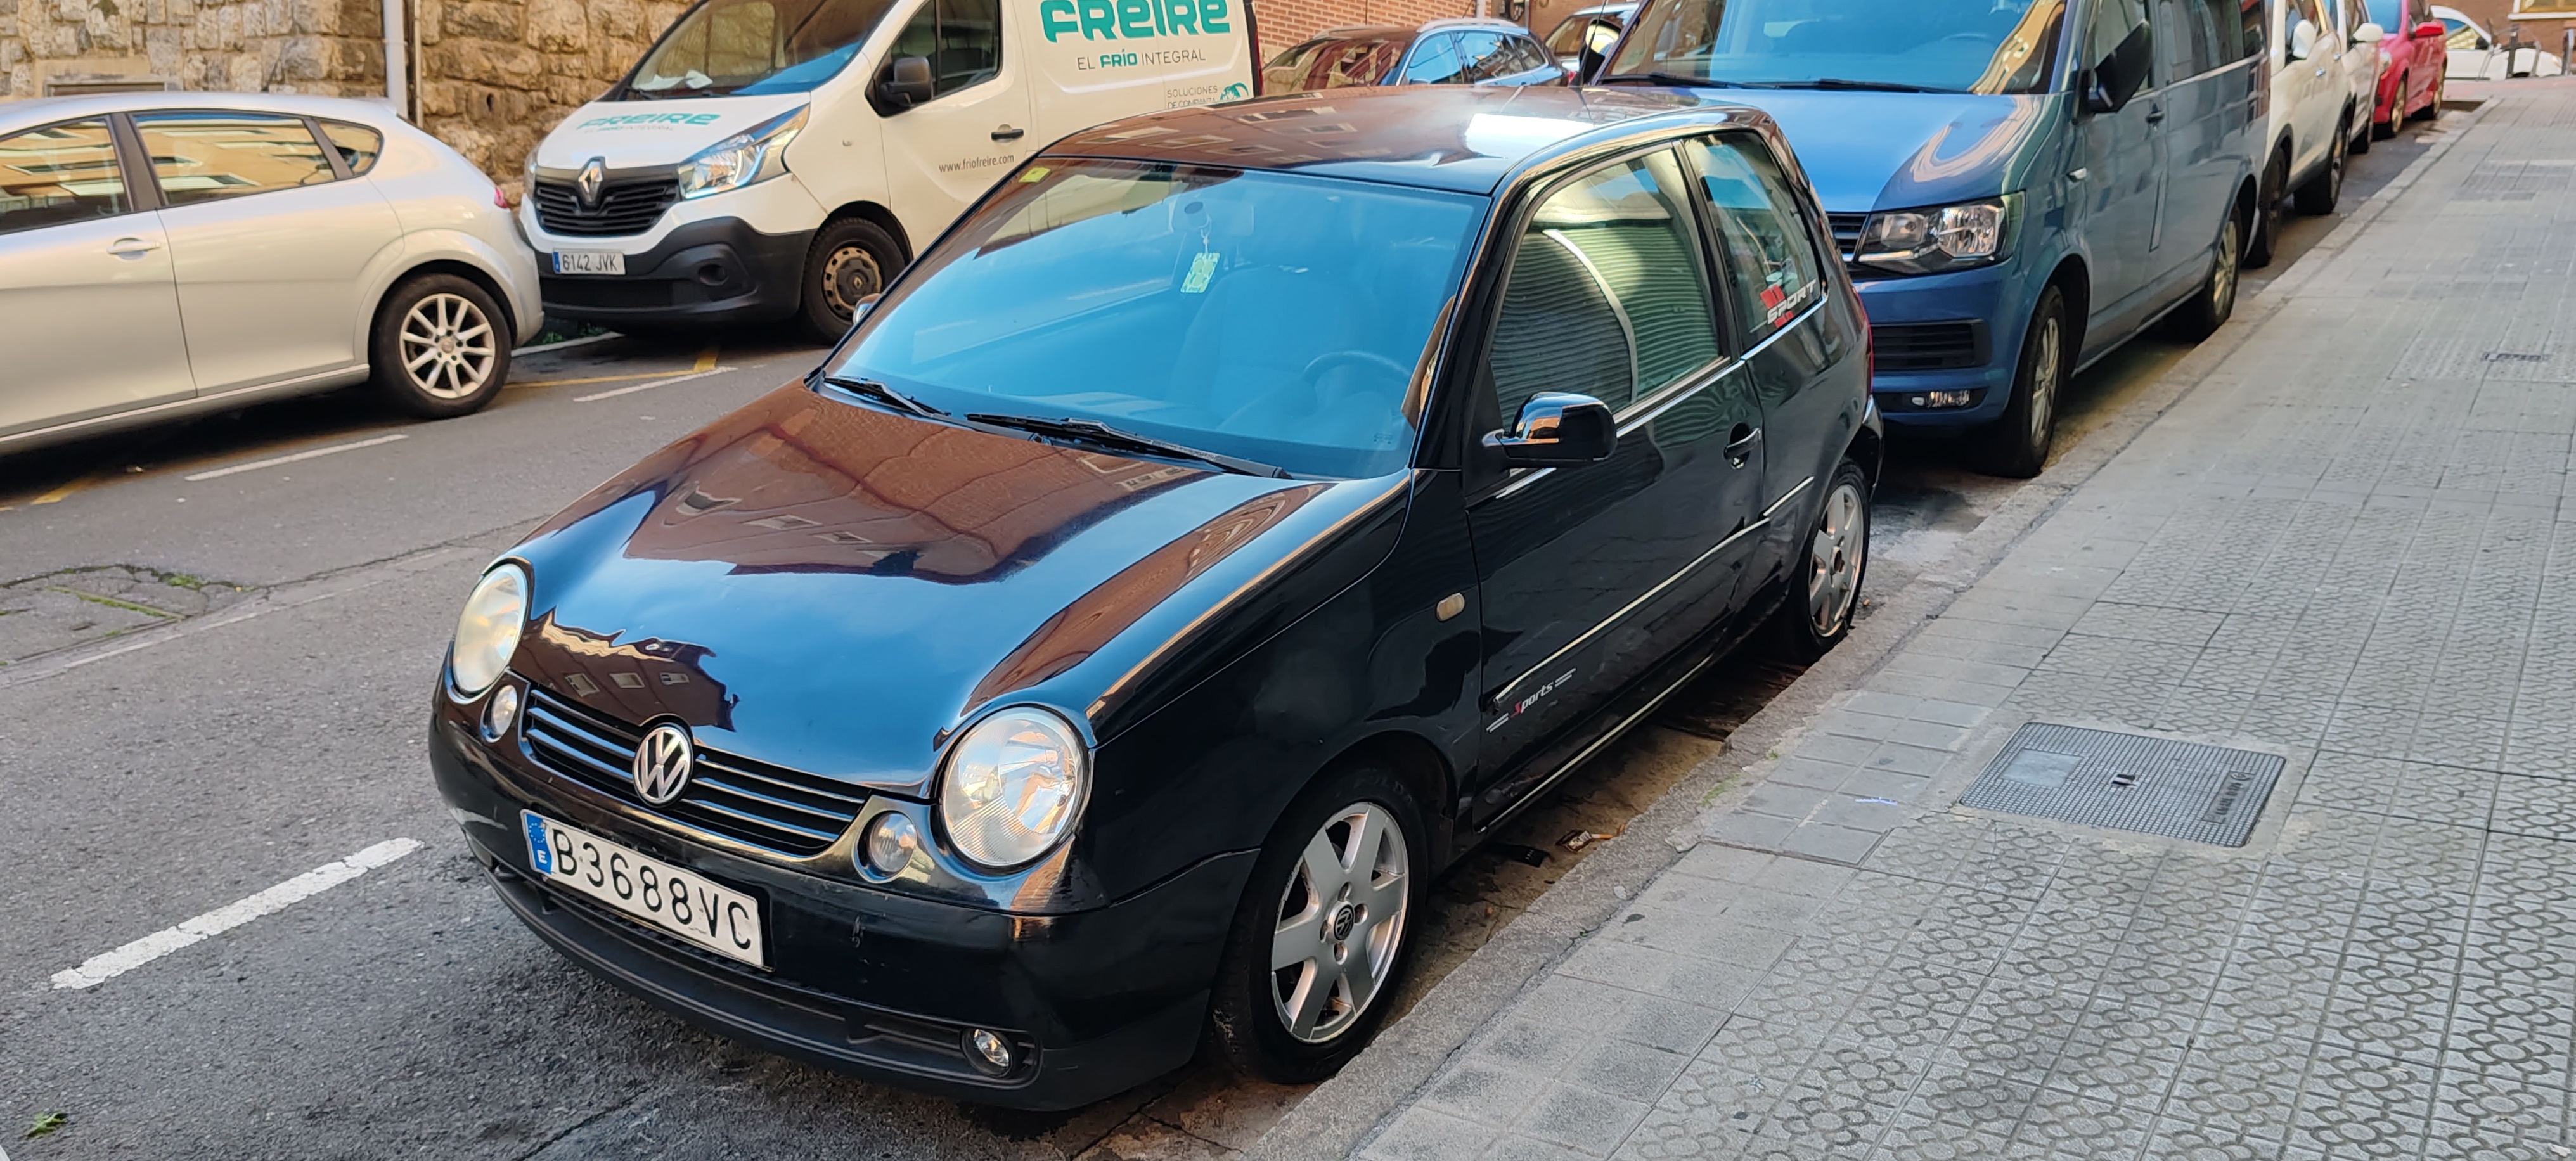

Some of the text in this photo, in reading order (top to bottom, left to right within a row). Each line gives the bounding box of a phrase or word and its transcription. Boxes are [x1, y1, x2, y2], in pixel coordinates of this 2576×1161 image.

[1077, 48, 1206, 70] EL FRÍO INTEGRAL
[1167, 86, 1218, 98] SOLUCIONES
[939, 155, 1015, 173] www.friofreire.com
[562, 254, 618, 271] 6142 JVK
[1767, 278, 1817, 324] SPORT
[1510, 681, 1554, 718] Sports
[634, 726, 693, 804] VW
[537, 849, 548, 864] E
[552, 828, 752, 951] B3688VC
